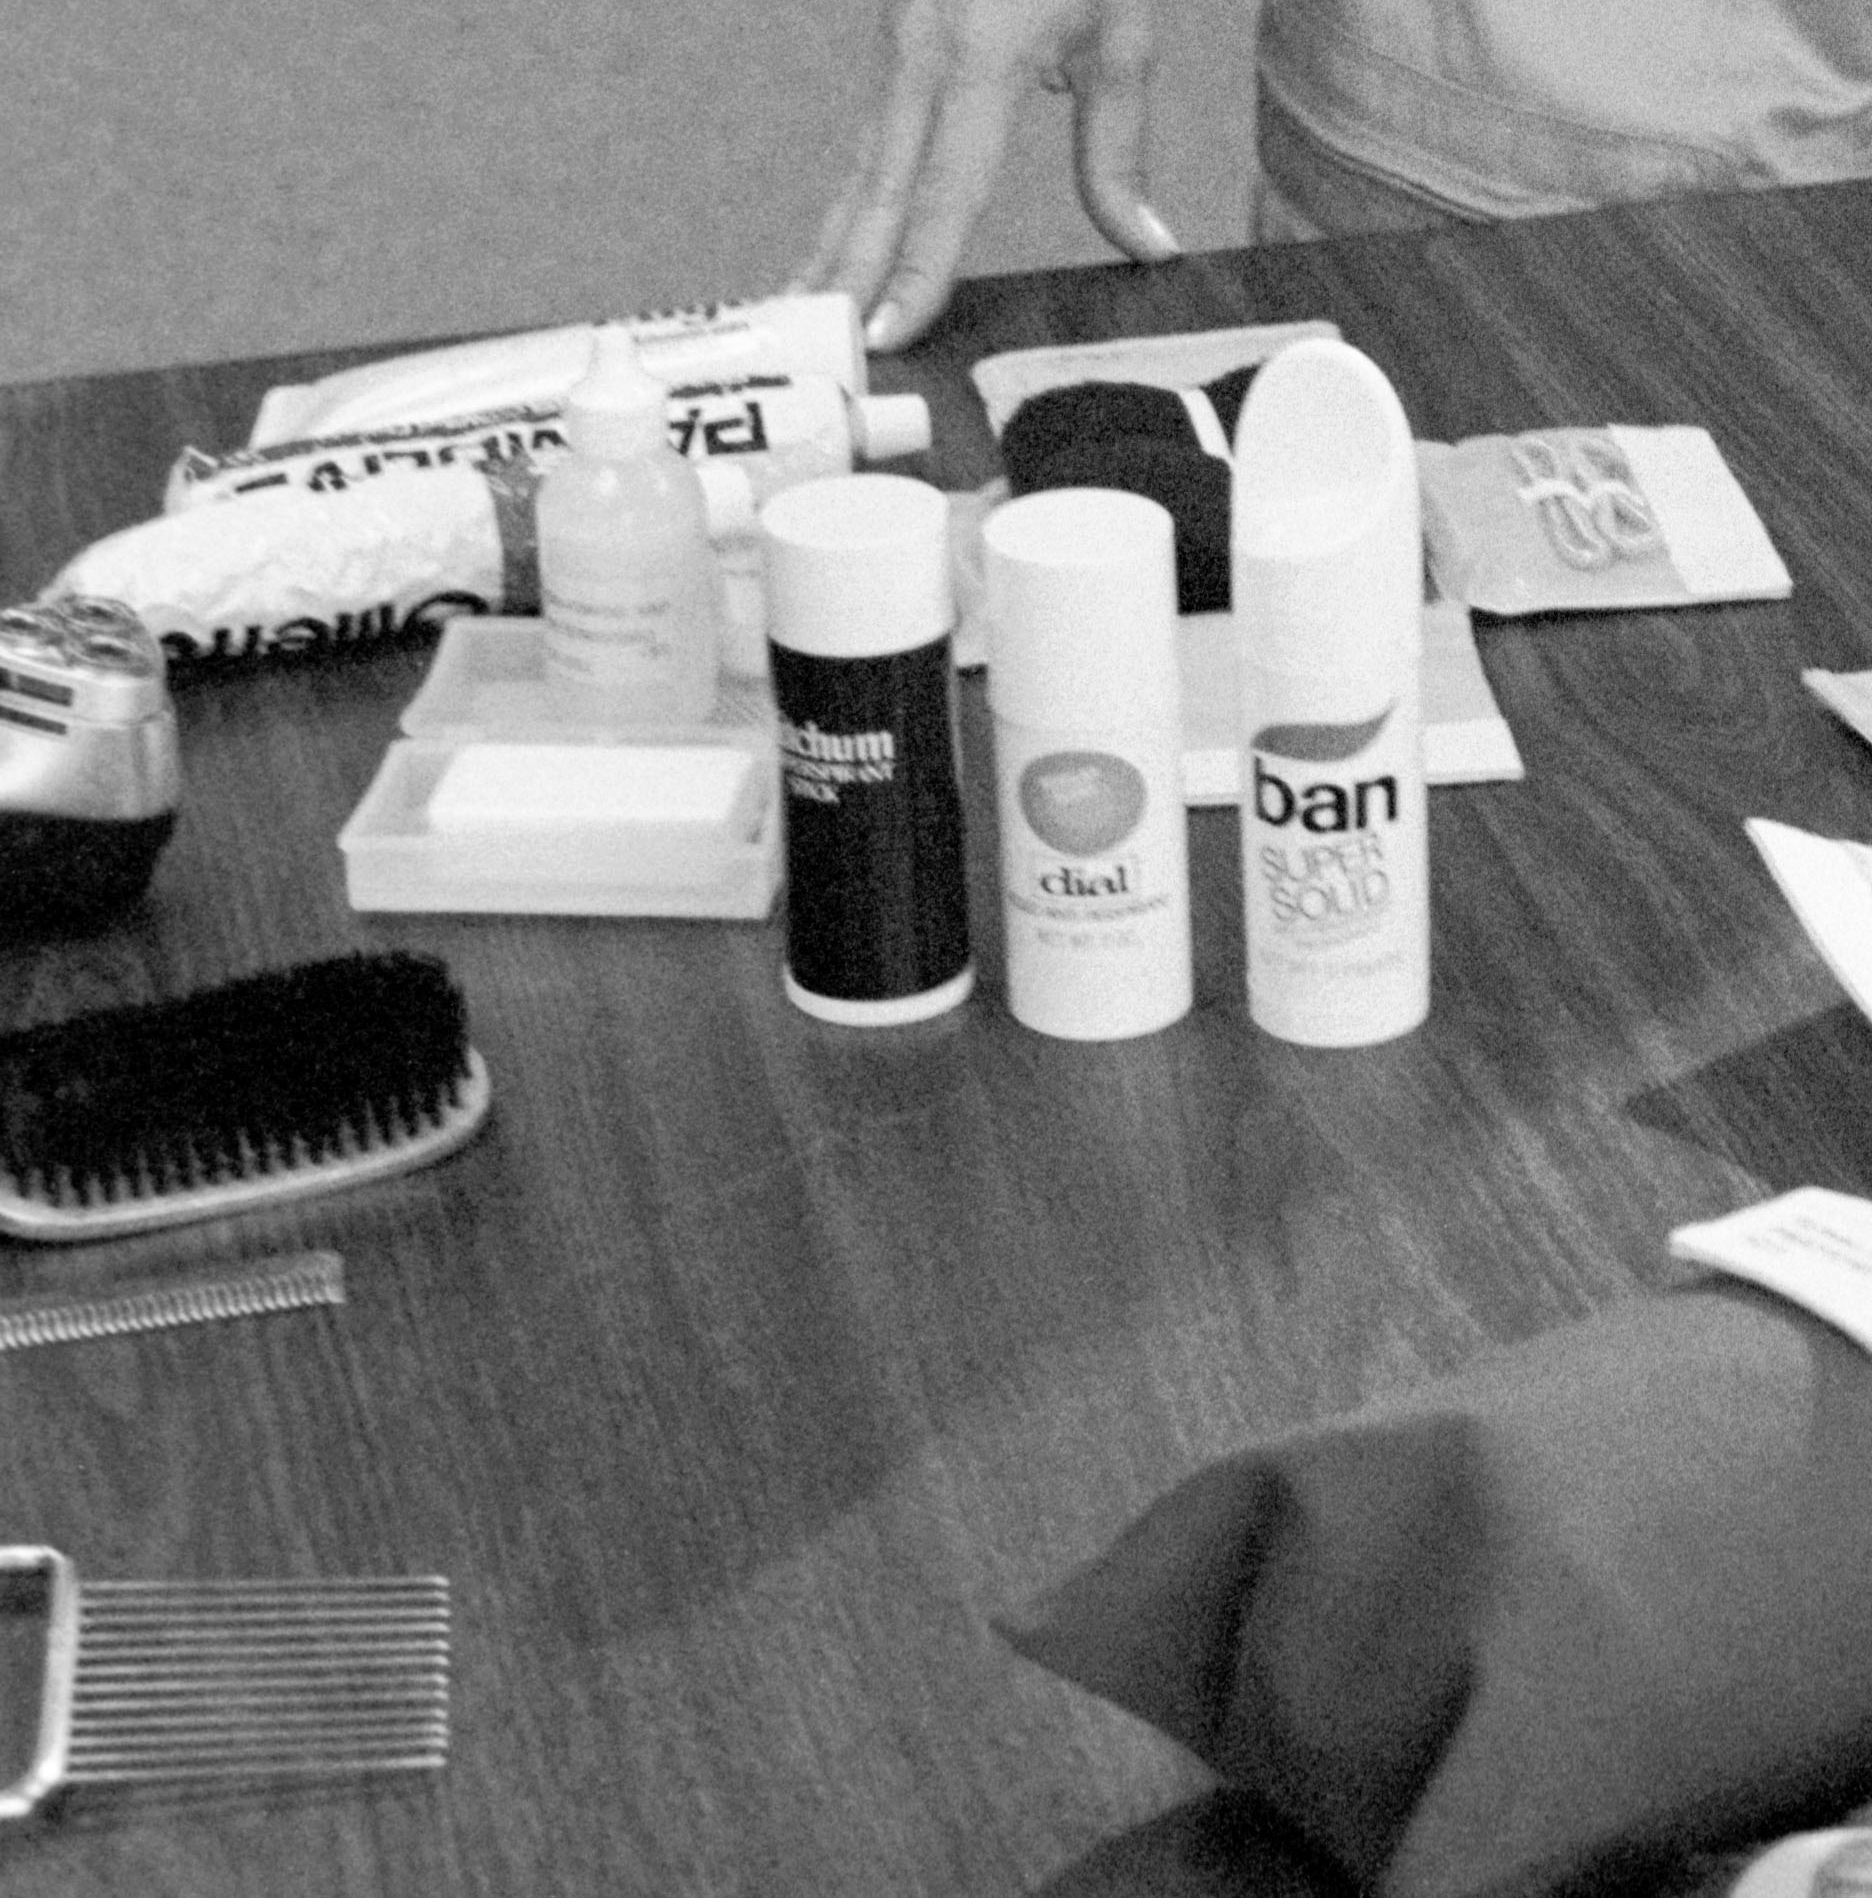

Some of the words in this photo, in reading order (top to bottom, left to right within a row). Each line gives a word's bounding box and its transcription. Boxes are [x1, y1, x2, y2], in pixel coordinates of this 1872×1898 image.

[1254, 755, 1398, 834] ban
[1039, 864, 1130, 897] dial
[1270, 868, 1390, 923] SOLID
